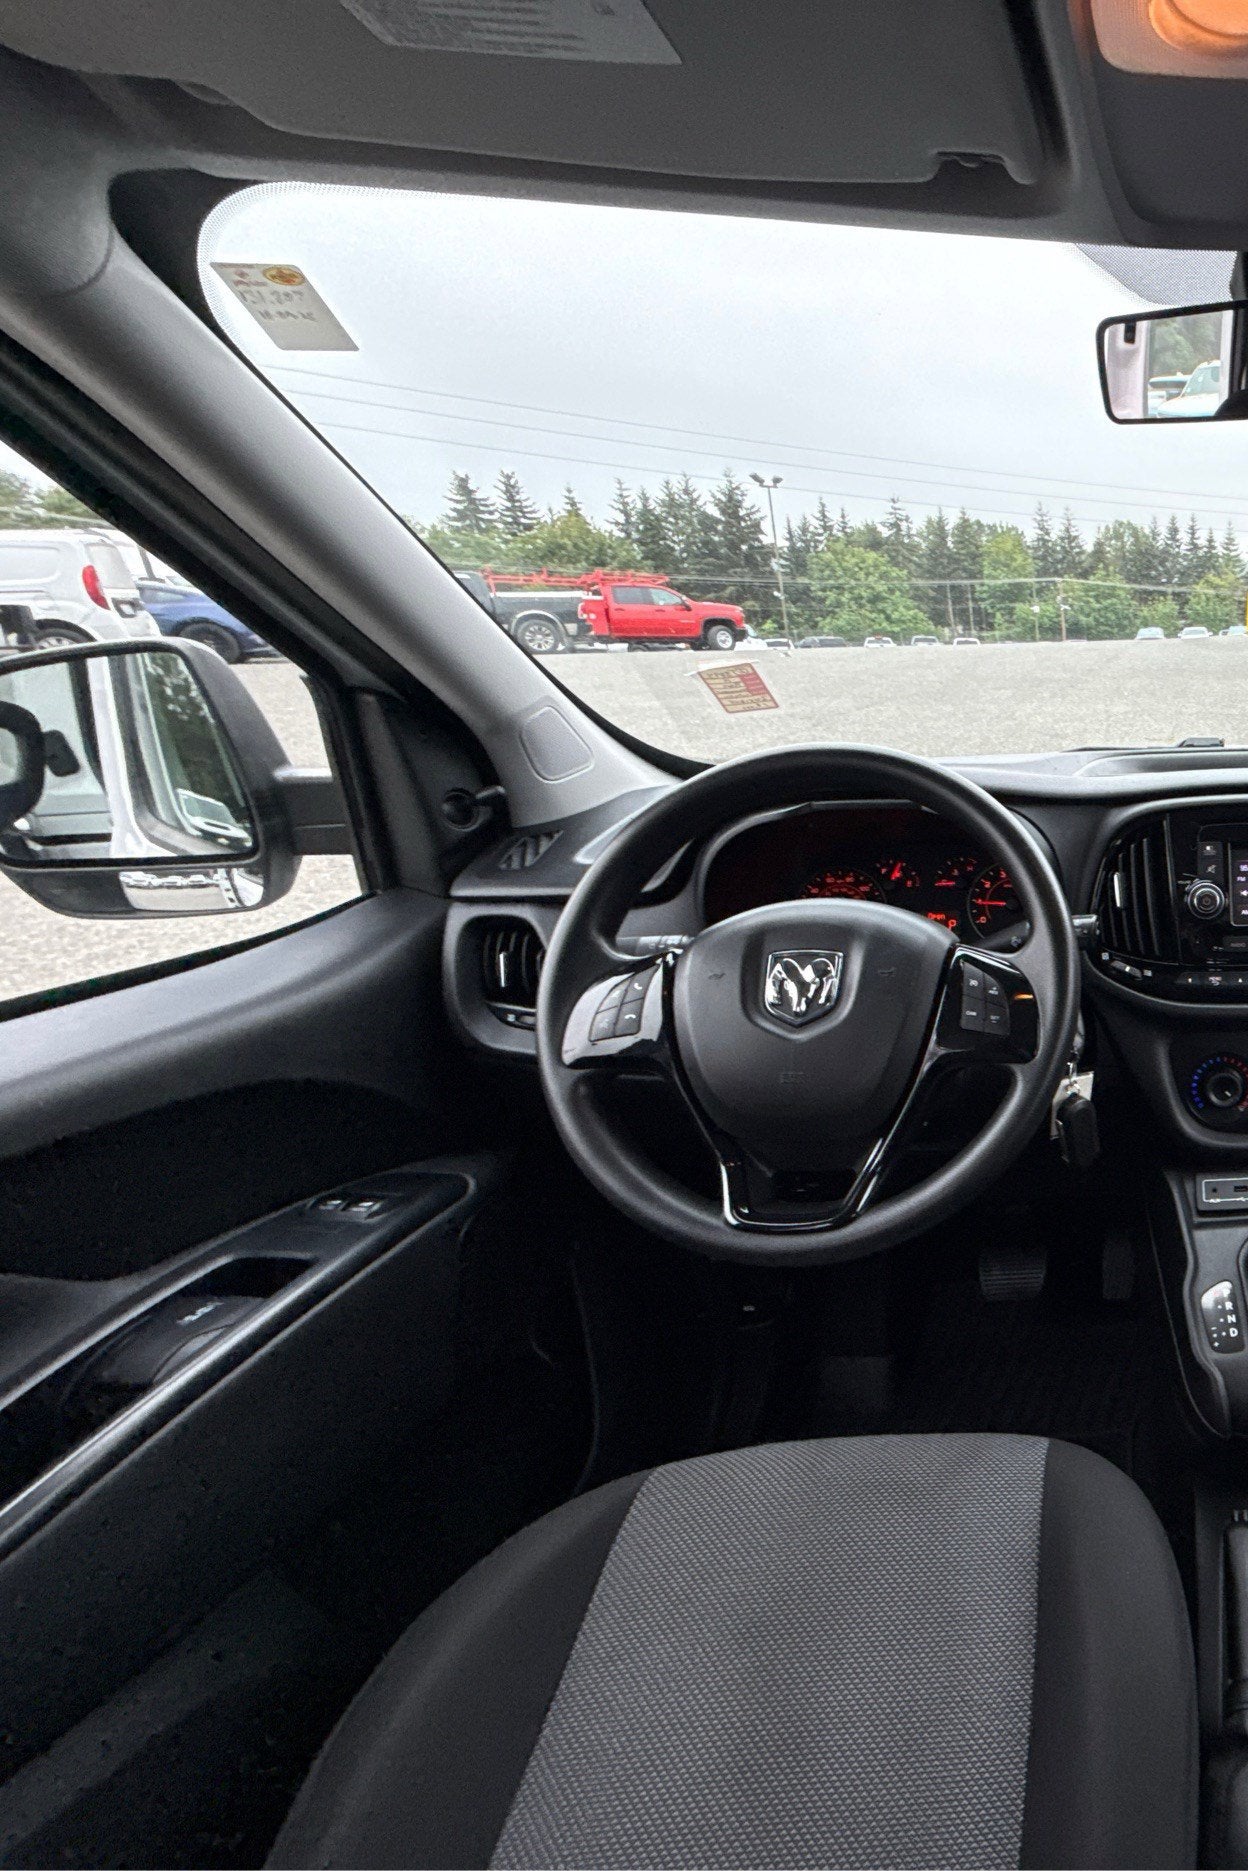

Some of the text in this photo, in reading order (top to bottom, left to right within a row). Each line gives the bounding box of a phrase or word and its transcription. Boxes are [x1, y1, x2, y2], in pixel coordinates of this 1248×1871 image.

[1225, 1301, 1233, 1311] R
[1227, 1314, 1236, 1324] N
[1229, 1327, 1239, 1338] D
